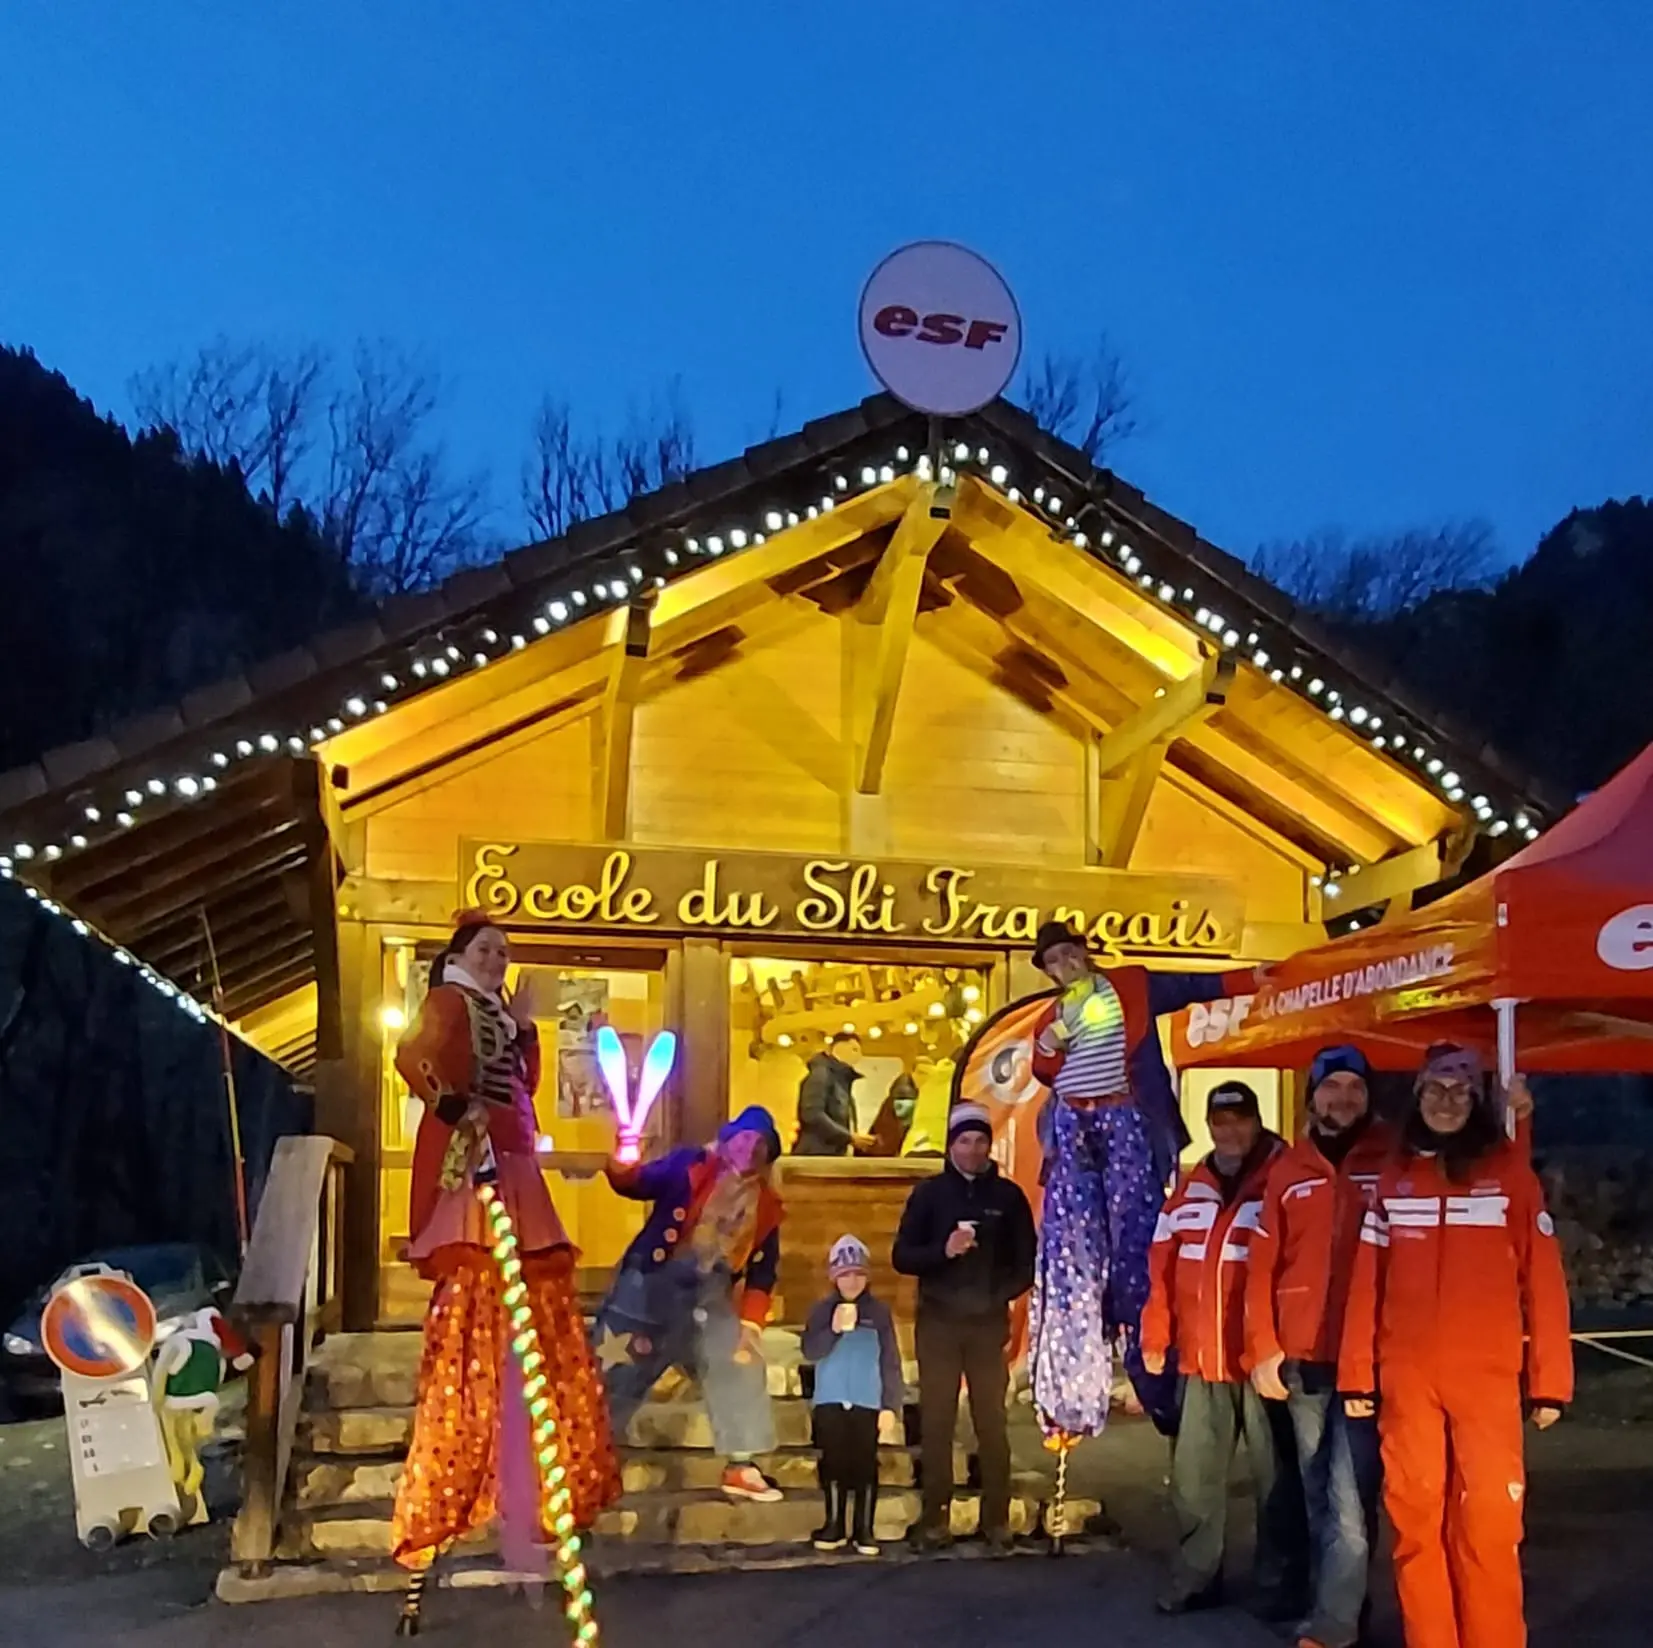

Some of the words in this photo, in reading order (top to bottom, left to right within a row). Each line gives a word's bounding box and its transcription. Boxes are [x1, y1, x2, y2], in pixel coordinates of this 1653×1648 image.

[466, 844, 660, 924] Ecole
[678, 860, 779, 927] du
[795, 861, 906, 934] Ski
[1275, 973, 1344, 1016] CHAPELLE
